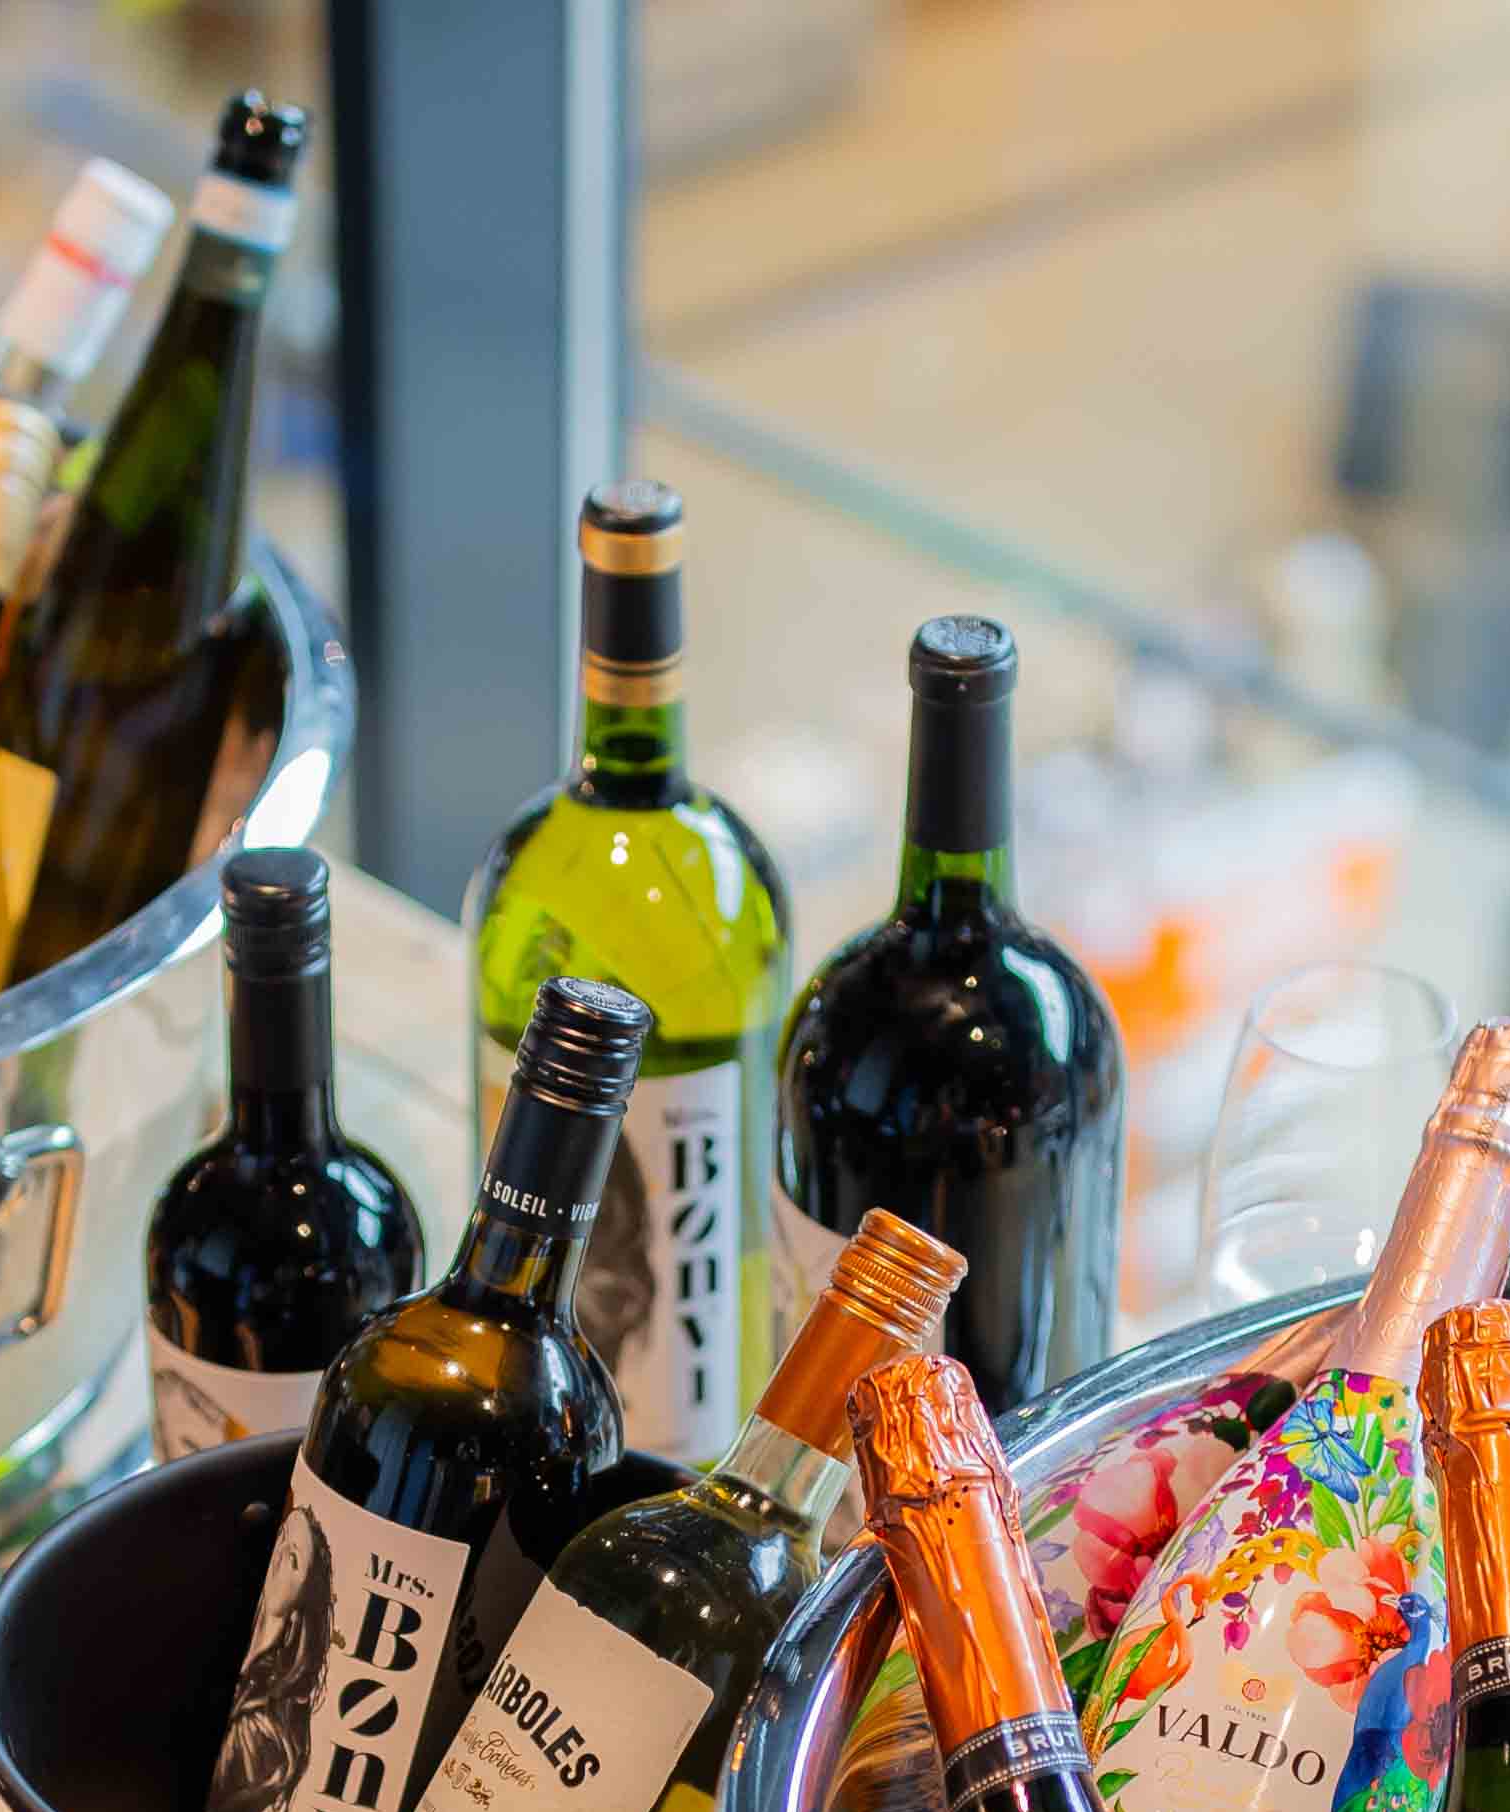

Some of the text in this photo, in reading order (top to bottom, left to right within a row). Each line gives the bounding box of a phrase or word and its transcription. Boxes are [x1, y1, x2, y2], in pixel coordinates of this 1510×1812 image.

[492, 1180, 547, 1218] SOLEIL
[363, 1551, 435, 1600] Mrs.
[1009, 1731, 1077, 1758] BRUT
[1157, 1703, 1327, 1786] VALDO
